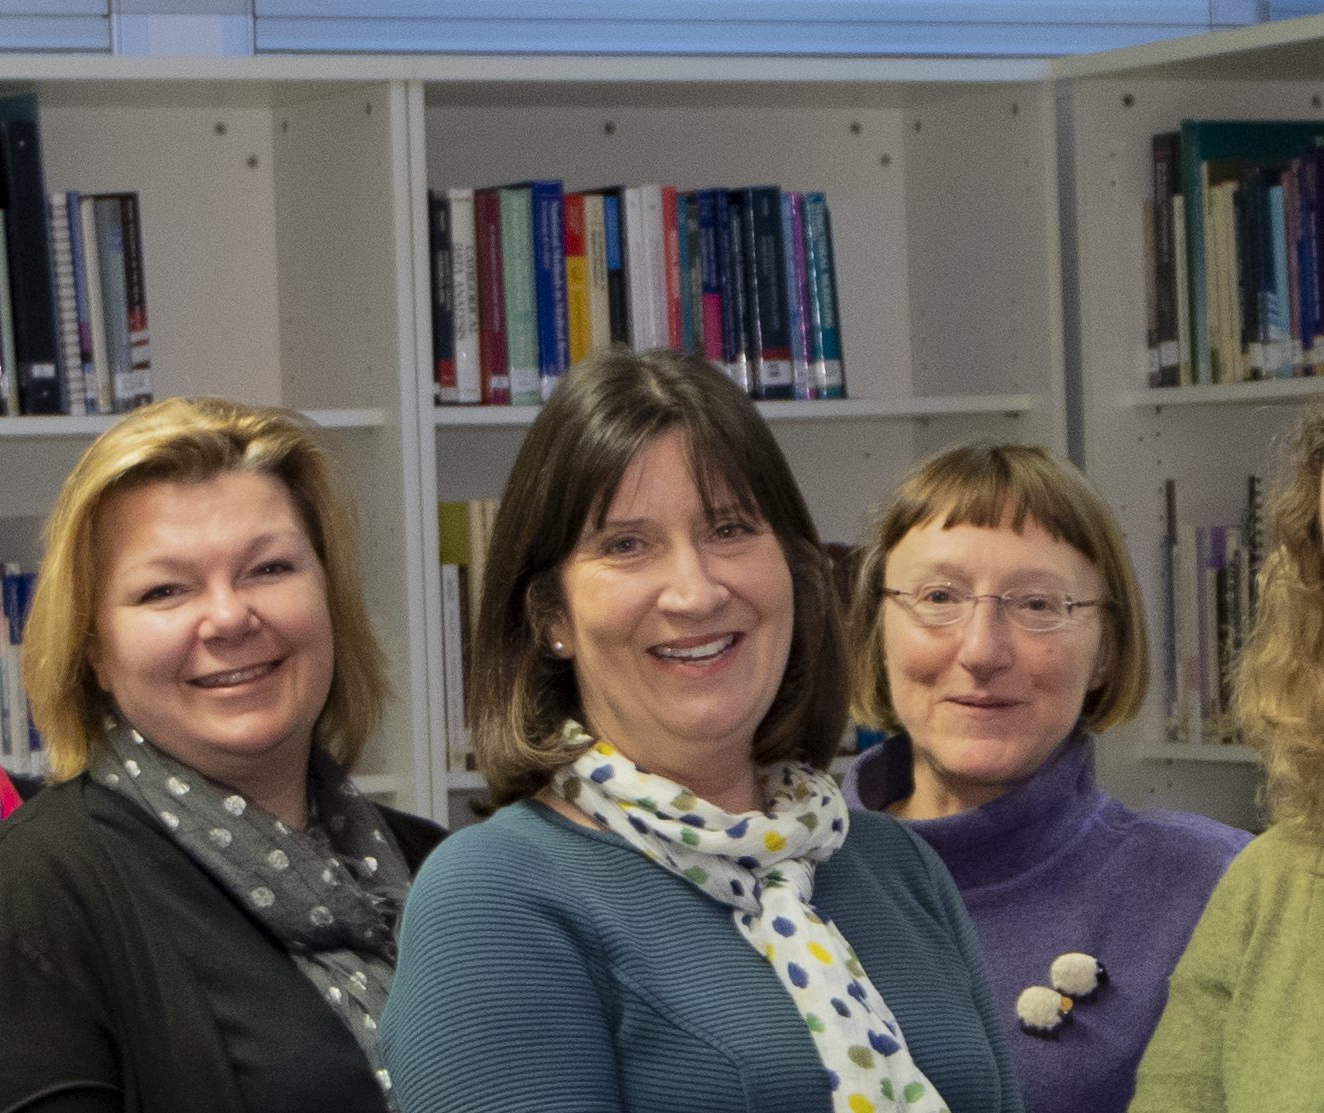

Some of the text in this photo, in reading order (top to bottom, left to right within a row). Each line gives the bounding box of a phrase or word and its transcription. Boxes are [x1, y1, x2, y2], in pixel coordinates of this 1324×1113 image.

[551, 201, 561, 246] Statistical
[466, 245, 478, 334] CATEGORICAL
[552, 249, 562, 289] Methods
